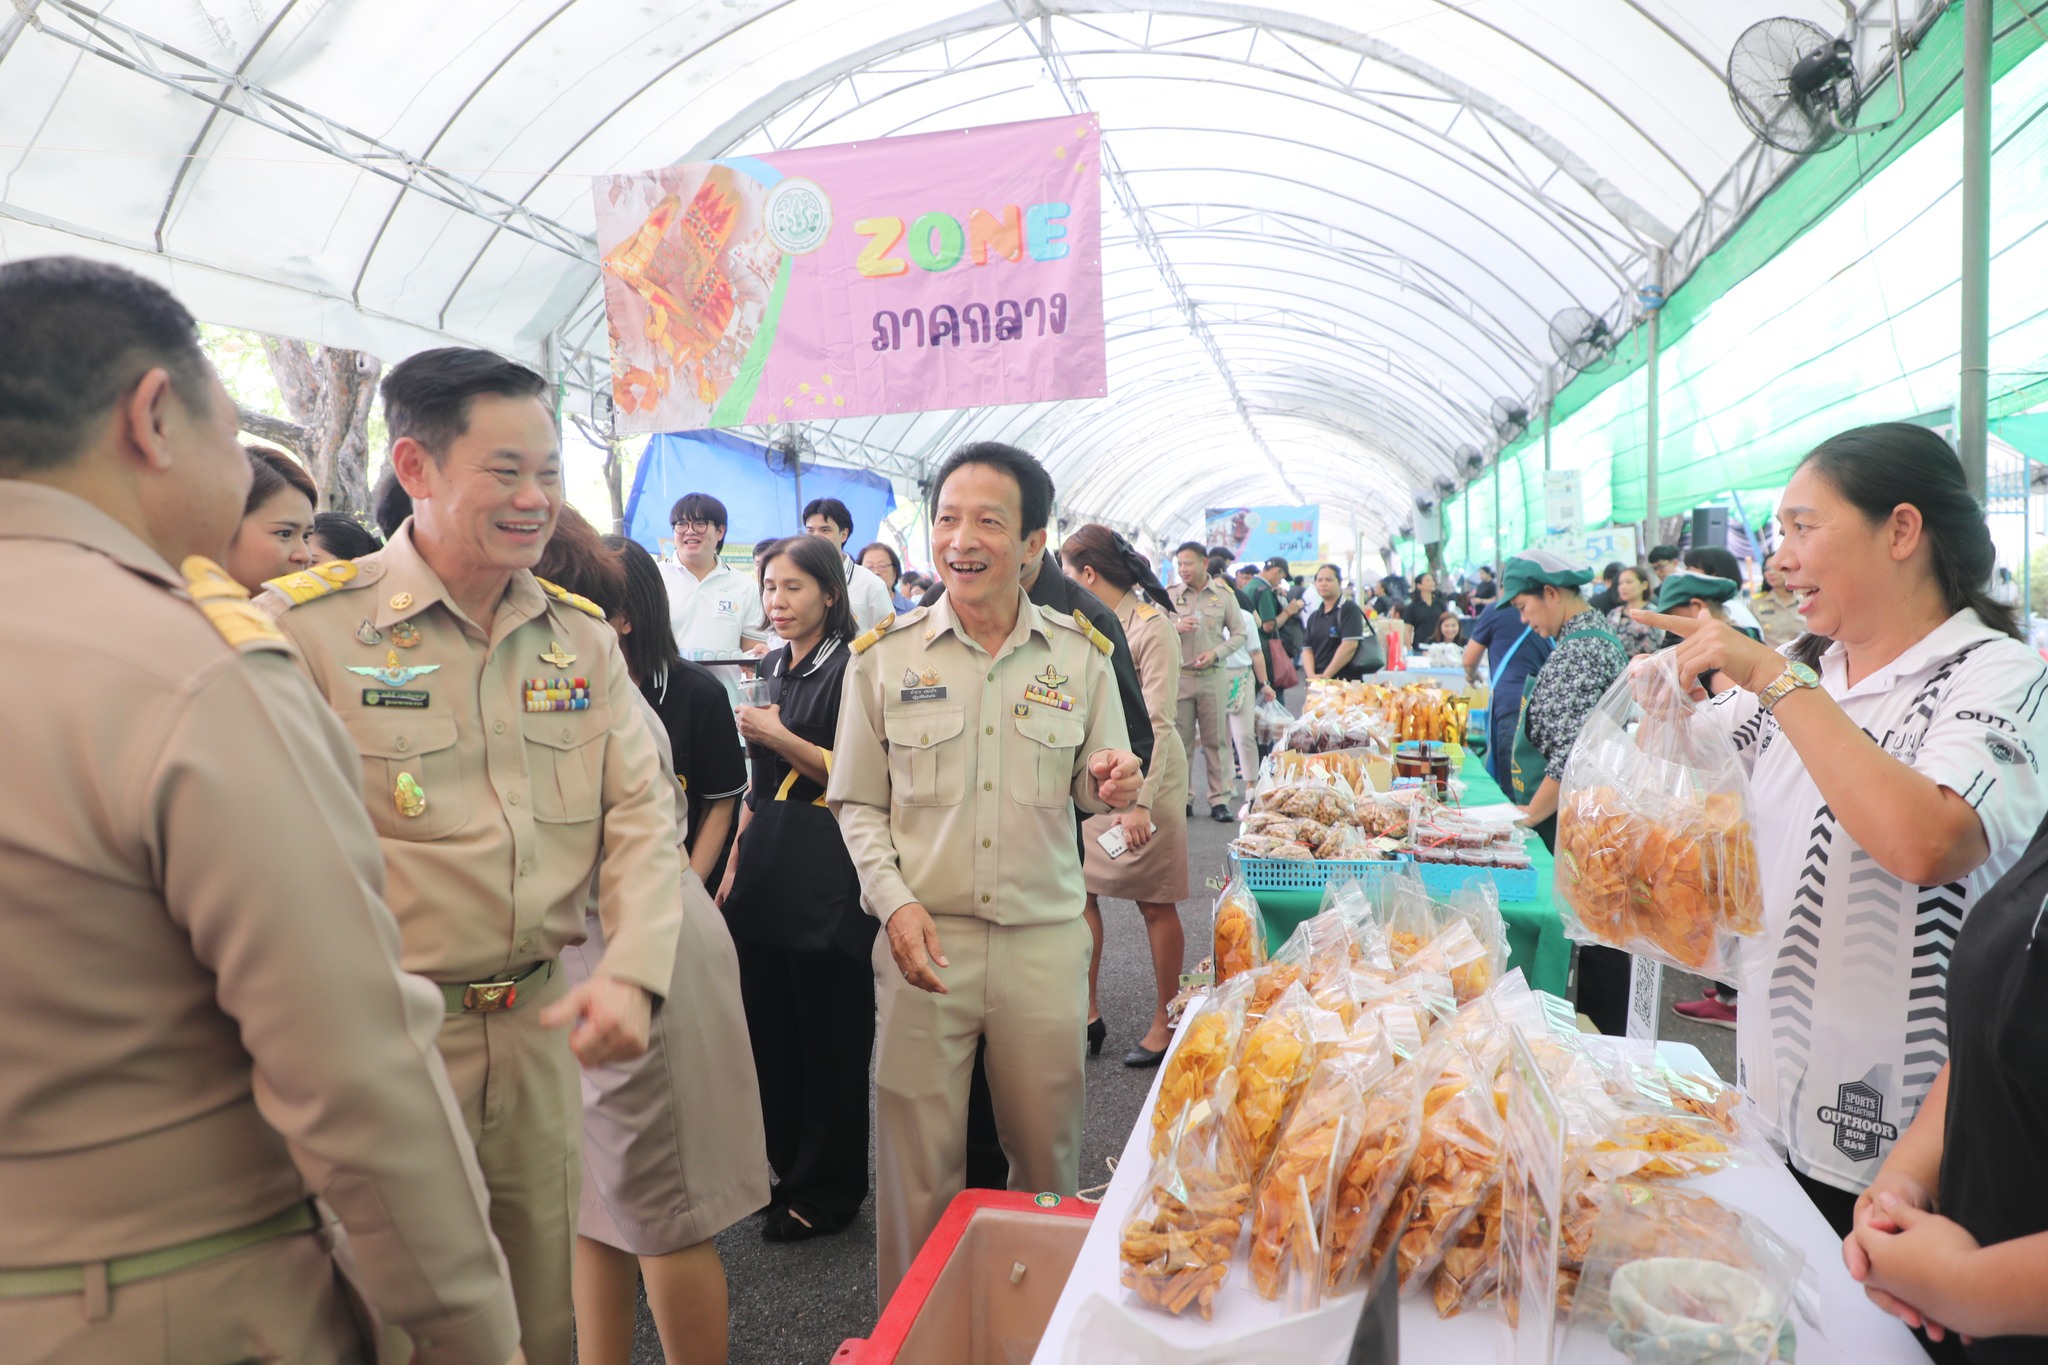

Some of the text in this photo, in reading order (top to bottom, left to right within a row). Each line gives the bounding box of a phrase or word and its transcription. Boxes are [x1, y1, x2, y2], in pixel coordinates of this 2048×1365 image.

[854, 202, 1071, 279] ZONE
[871, 292, 1068, 352] ภาคกลาง
[1267, 520, 1313, 534] ZONE
[1845, 1092, 1876, 1109] SPORTS
[1845, 1104, 1876, 1118] COLLECTION
[1845, 1129, 1867, 1140] RUN
[1843, 1139, 1867, 1152] B&W
